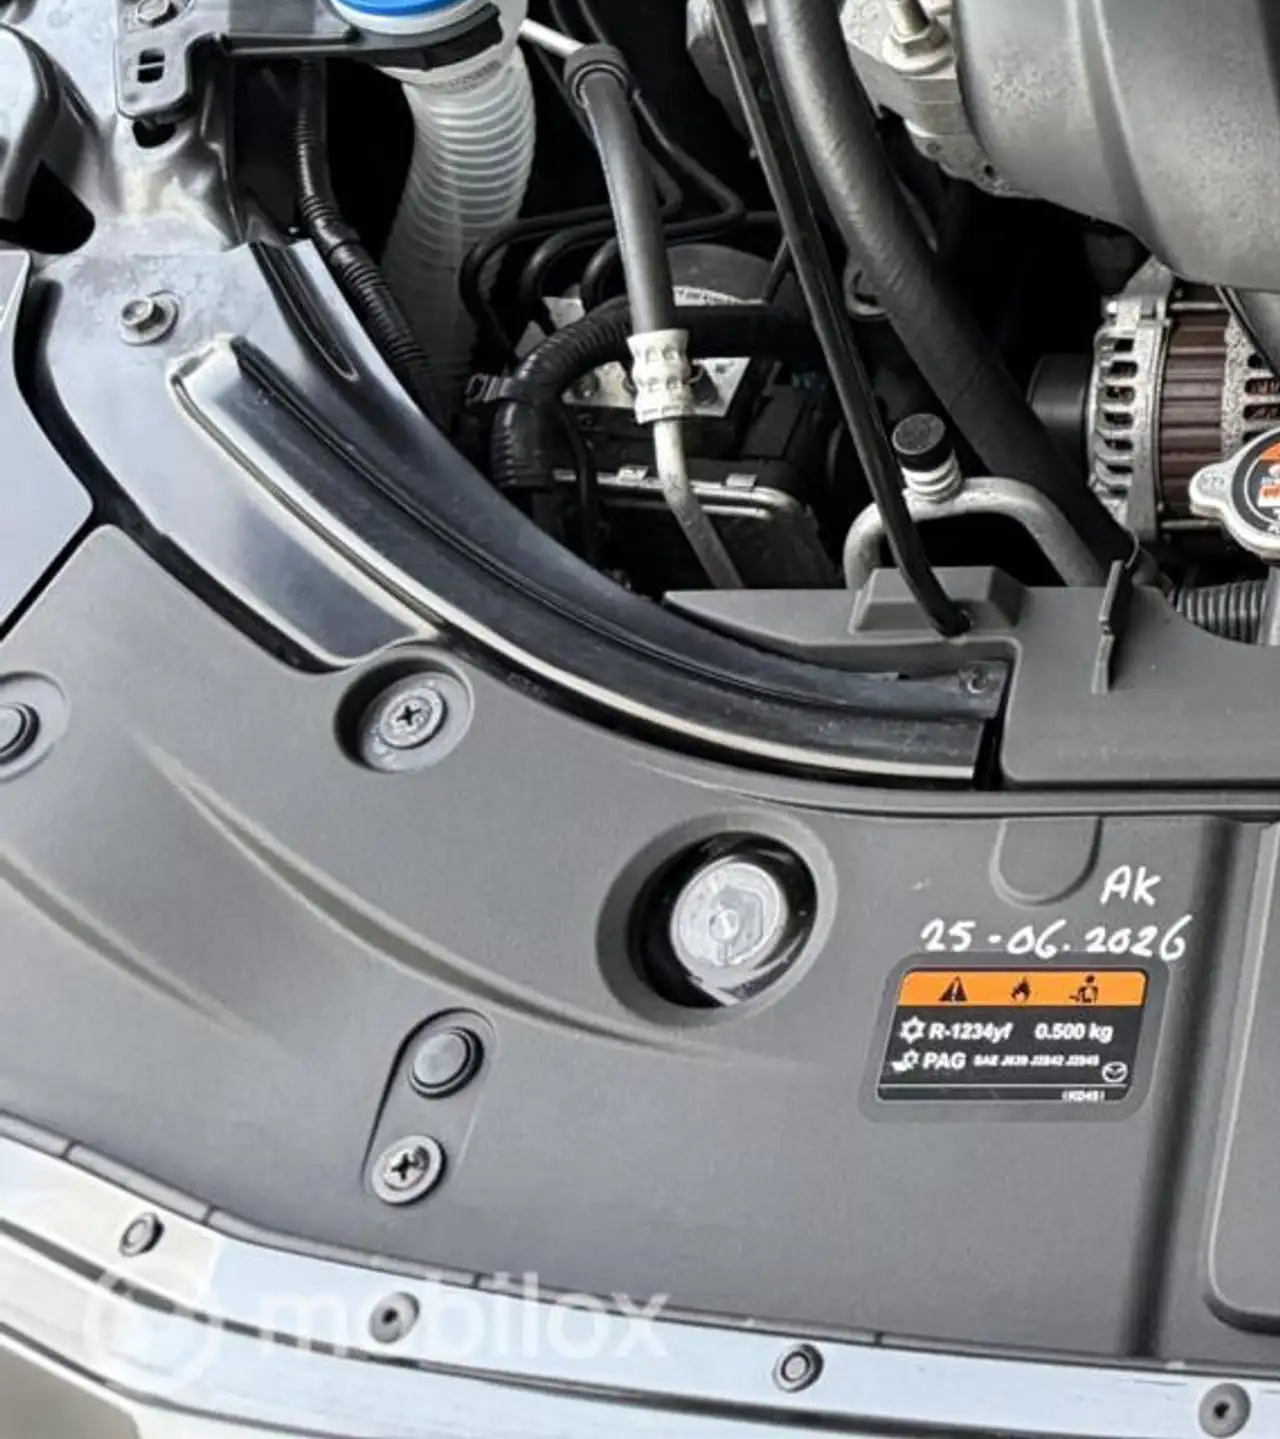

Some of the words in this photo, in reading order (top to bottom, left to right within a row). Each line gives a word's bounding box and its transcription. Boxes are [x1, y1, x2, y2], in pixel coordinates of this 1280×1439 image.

[1100, 864, 1161, 906] AK
[927, 1022, 1014, 1043] R-1234yf
[1034, 1022, 1086, 1040] 0.500
[1088, 1022, 1114, 1043] kg
[922, 1051, 967, 1070] PAG
